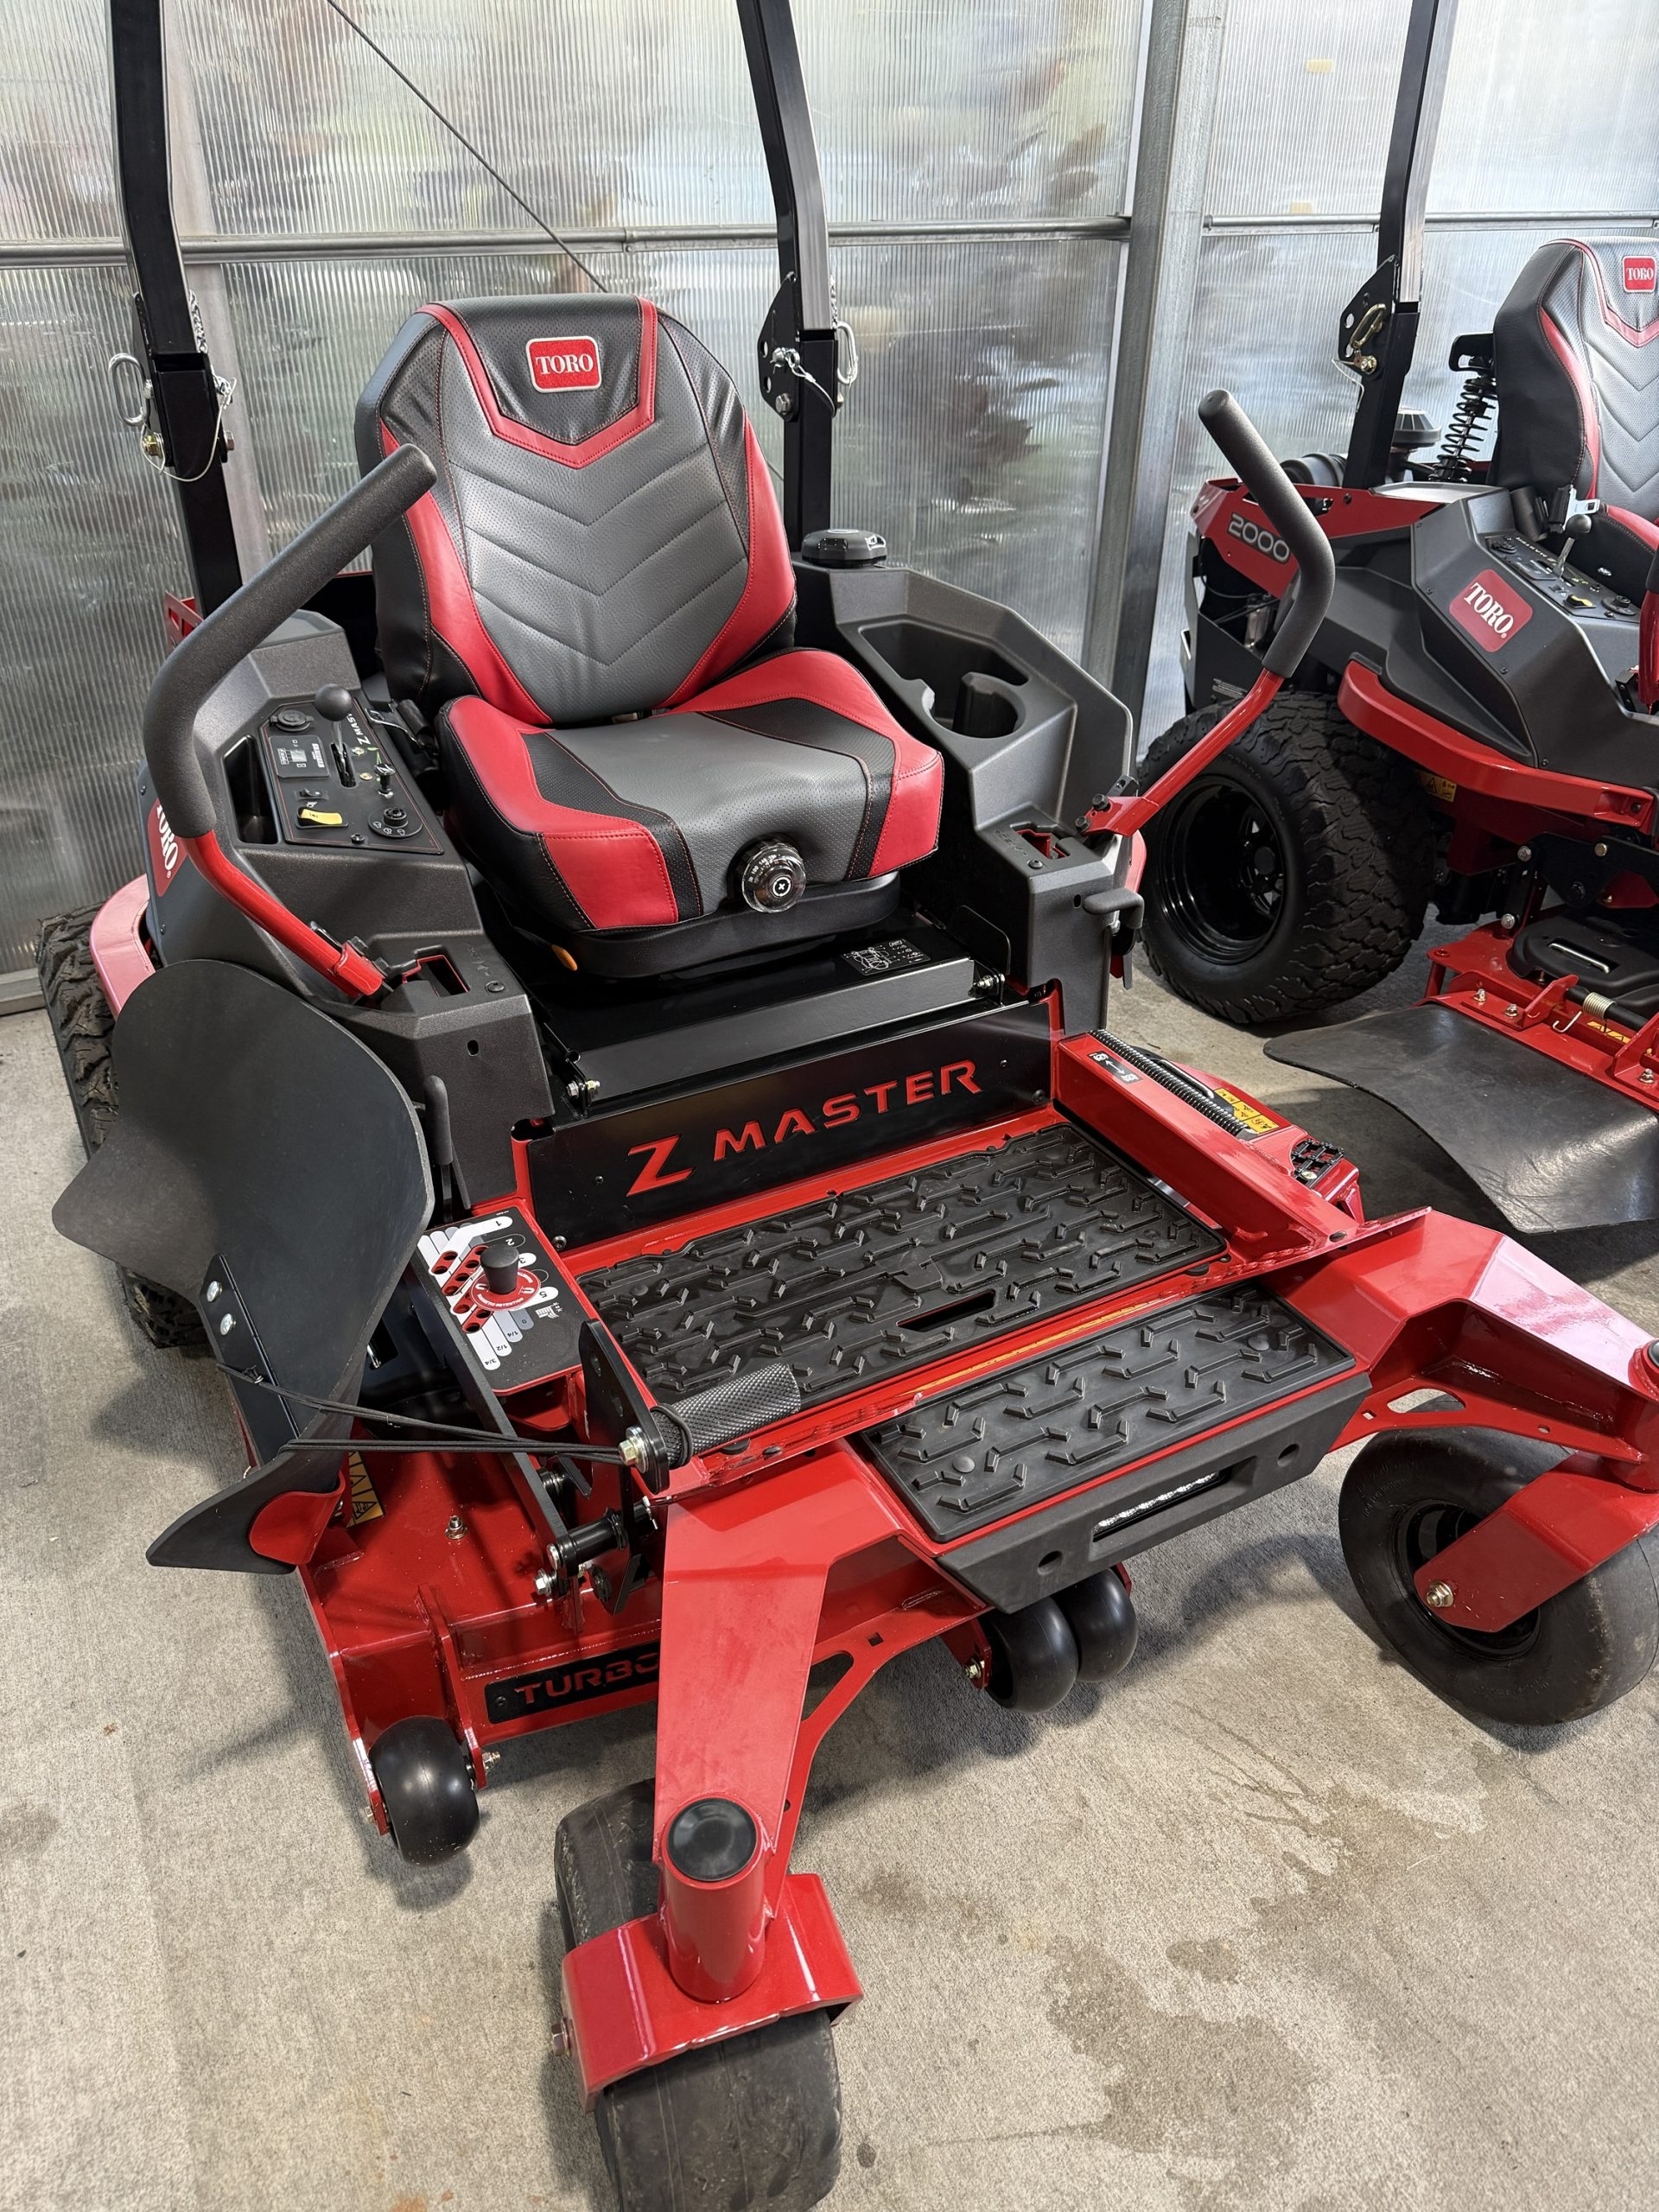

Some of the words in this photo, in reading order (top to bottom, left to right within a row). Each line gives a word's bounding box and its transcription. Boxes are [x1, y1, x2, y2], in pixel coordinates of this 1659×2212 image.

[1625, 267, 1654, 281] TORO
[535, 353, 594, 375] TORO
[1228, 512, 1290, 562] 2000
[1463, 582, 1514, 634] TORO
[346, 713, 364, 735] MAS
[356, 735, 372, 745] Z
[626, 1134, 696, 1198] Z
[713, 1058, 983, 1163] MASTER
[505, 1237, 515, 1246] 2
[514, 1651, 660, 1705] TURBO
